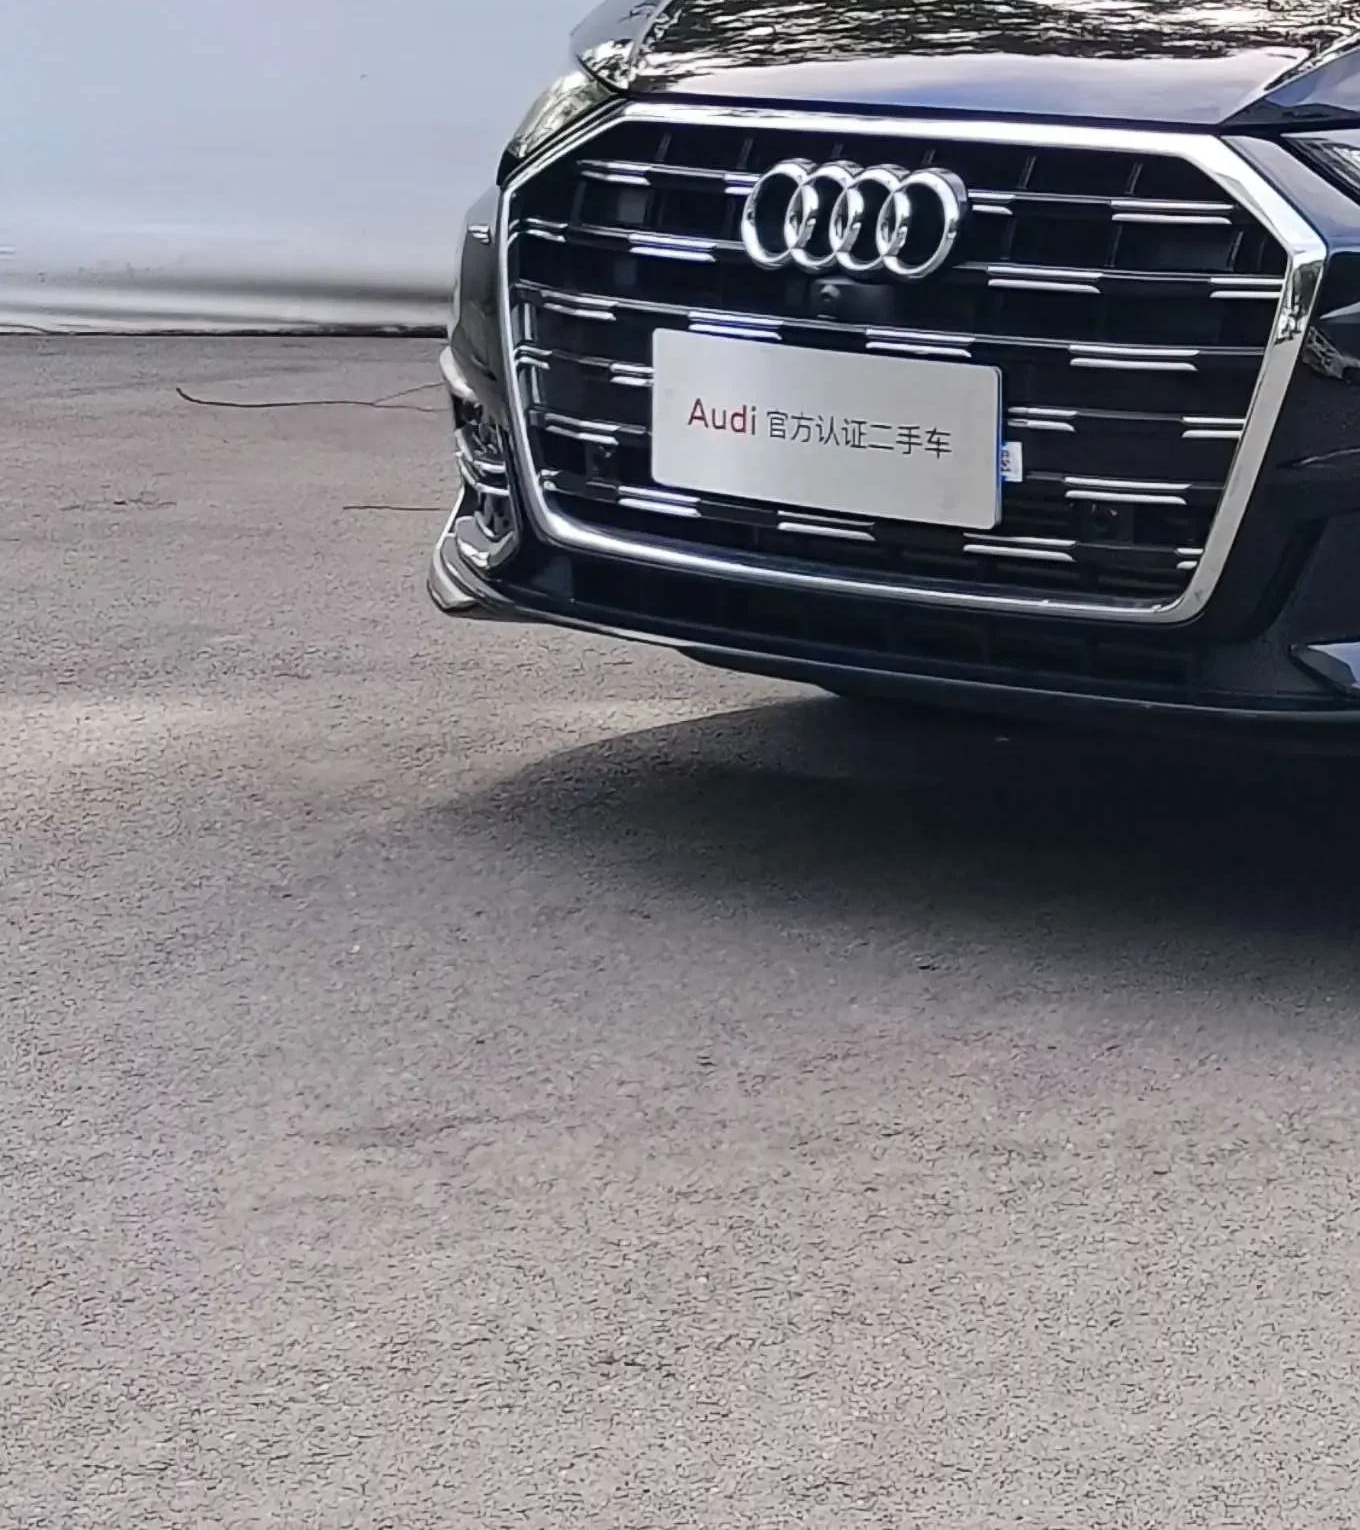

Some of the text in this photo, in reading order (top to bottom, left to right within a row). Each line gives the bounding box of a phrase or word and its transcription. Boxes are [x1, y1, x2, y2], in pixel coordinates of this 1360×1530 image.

[687, 398, 953, 460] Audi 官方认证二手车
